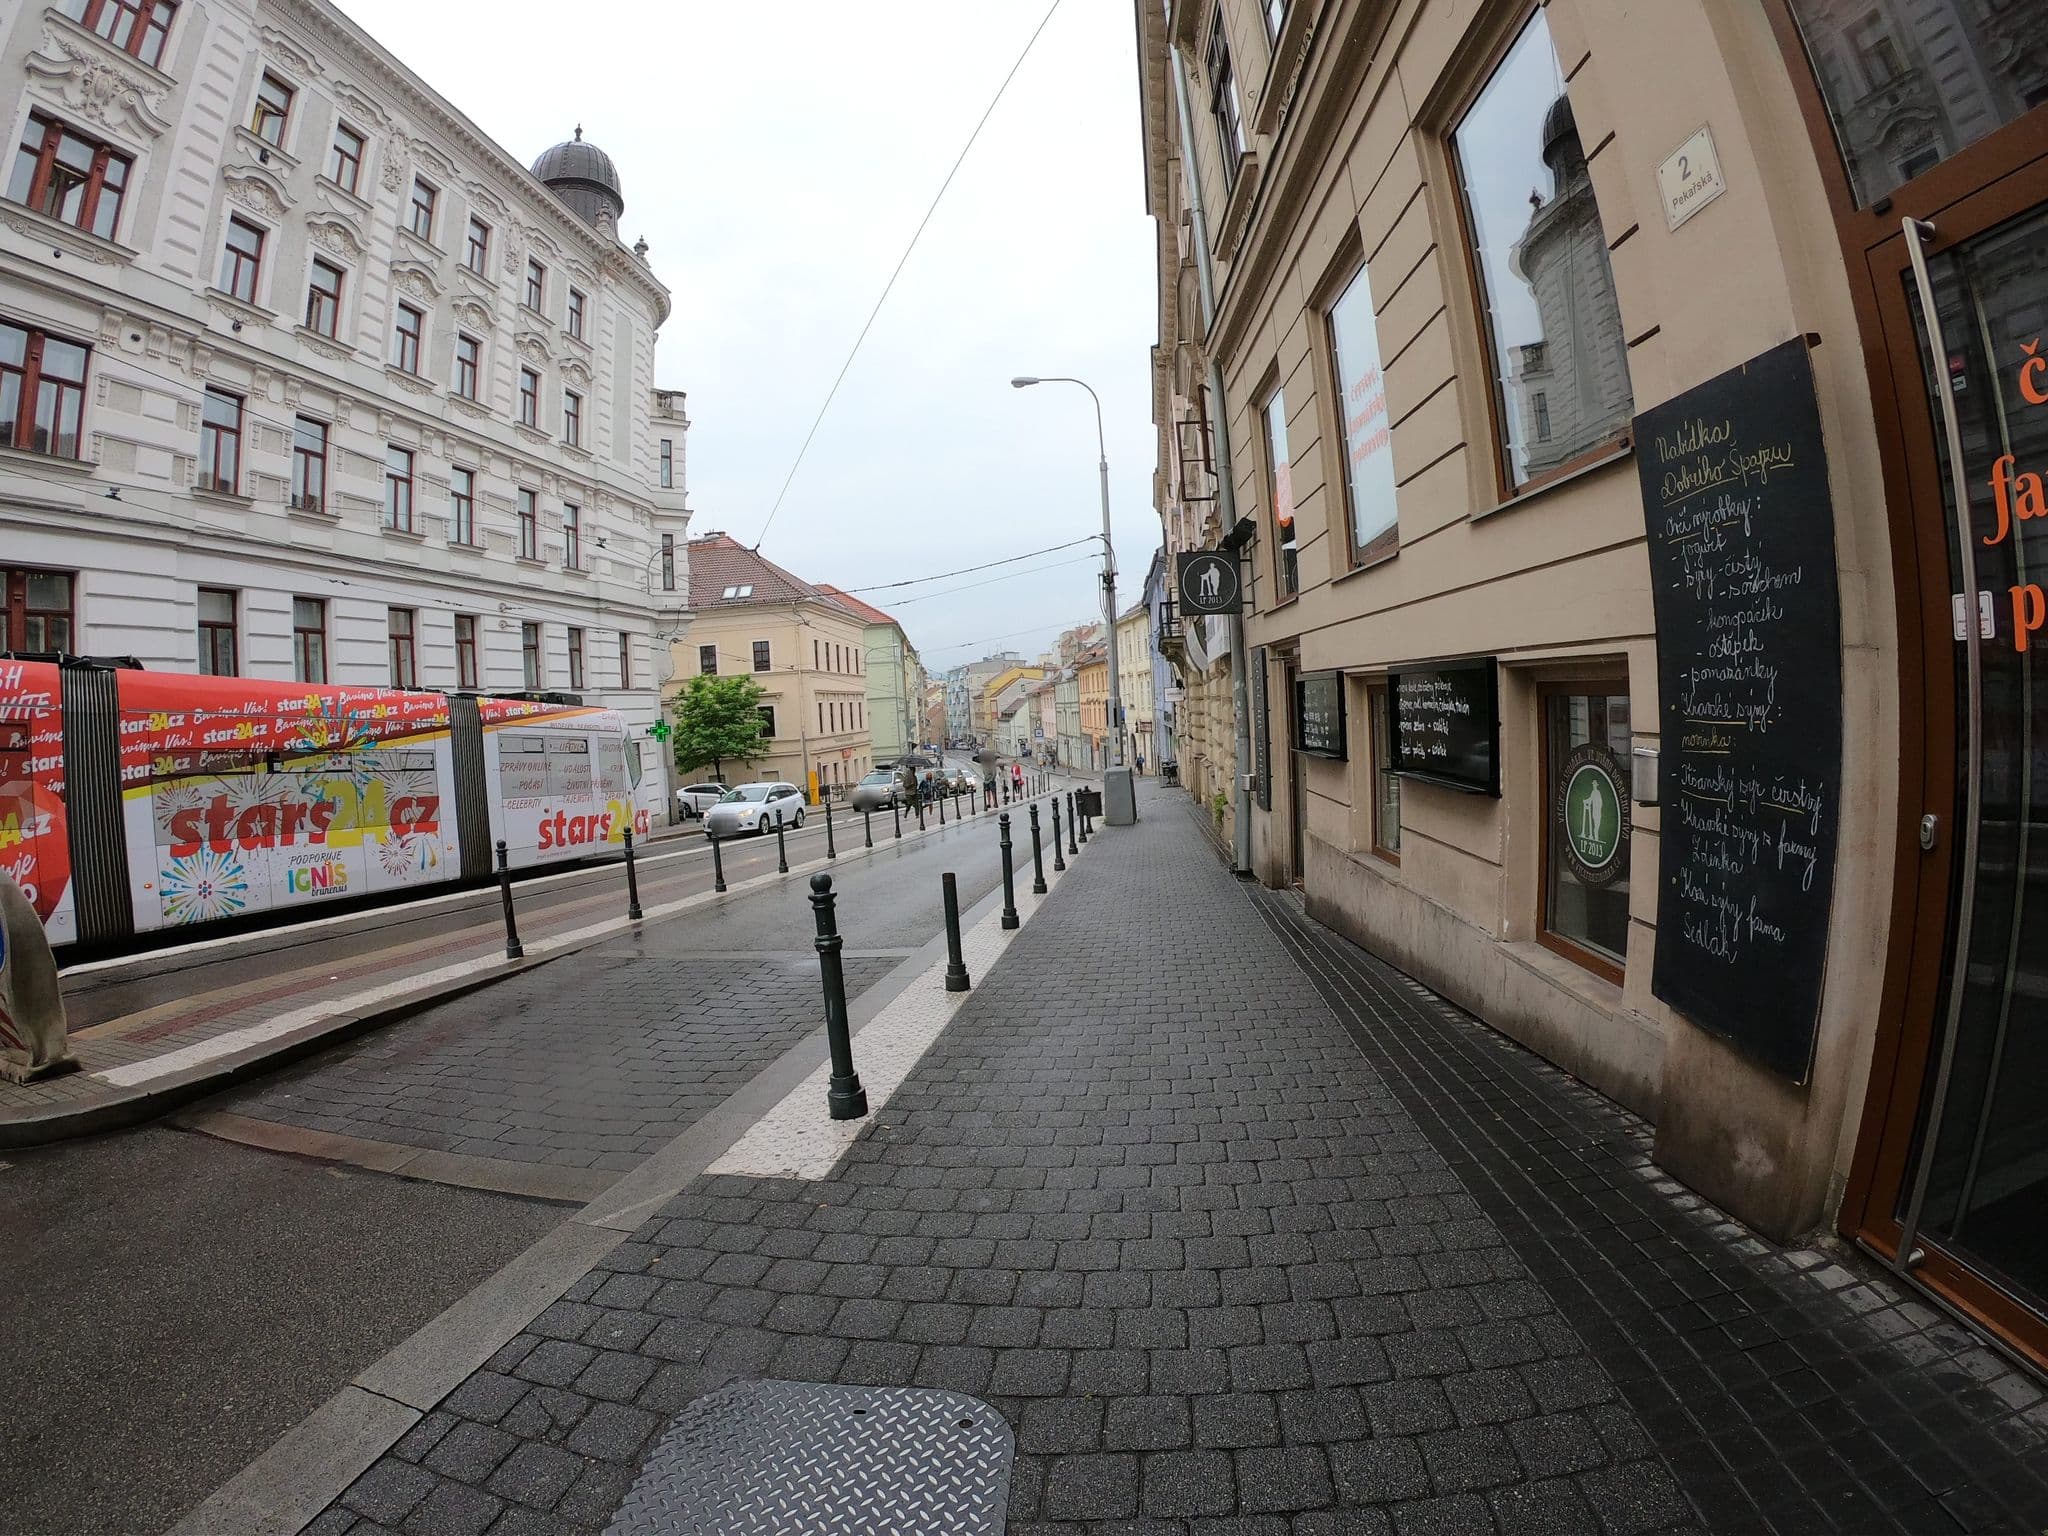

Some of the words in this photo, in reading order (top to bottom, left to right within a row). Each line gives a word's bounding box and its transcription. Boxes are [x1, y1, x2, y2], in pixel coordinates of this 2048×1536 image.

[1678, 156, 1692, 181] 2
[1672, 171, 1713, 209] Pekařská
[1655, 418, 1730, 463] Nabídka
[120, 713, 185, 734] tars24cz
[121, 739, 161, 755] avíme
[165, 731, 193, 749] Vás!
[1589, 842, 1603, 858] 2013
[287, 860, 348, 894] IGNIS
